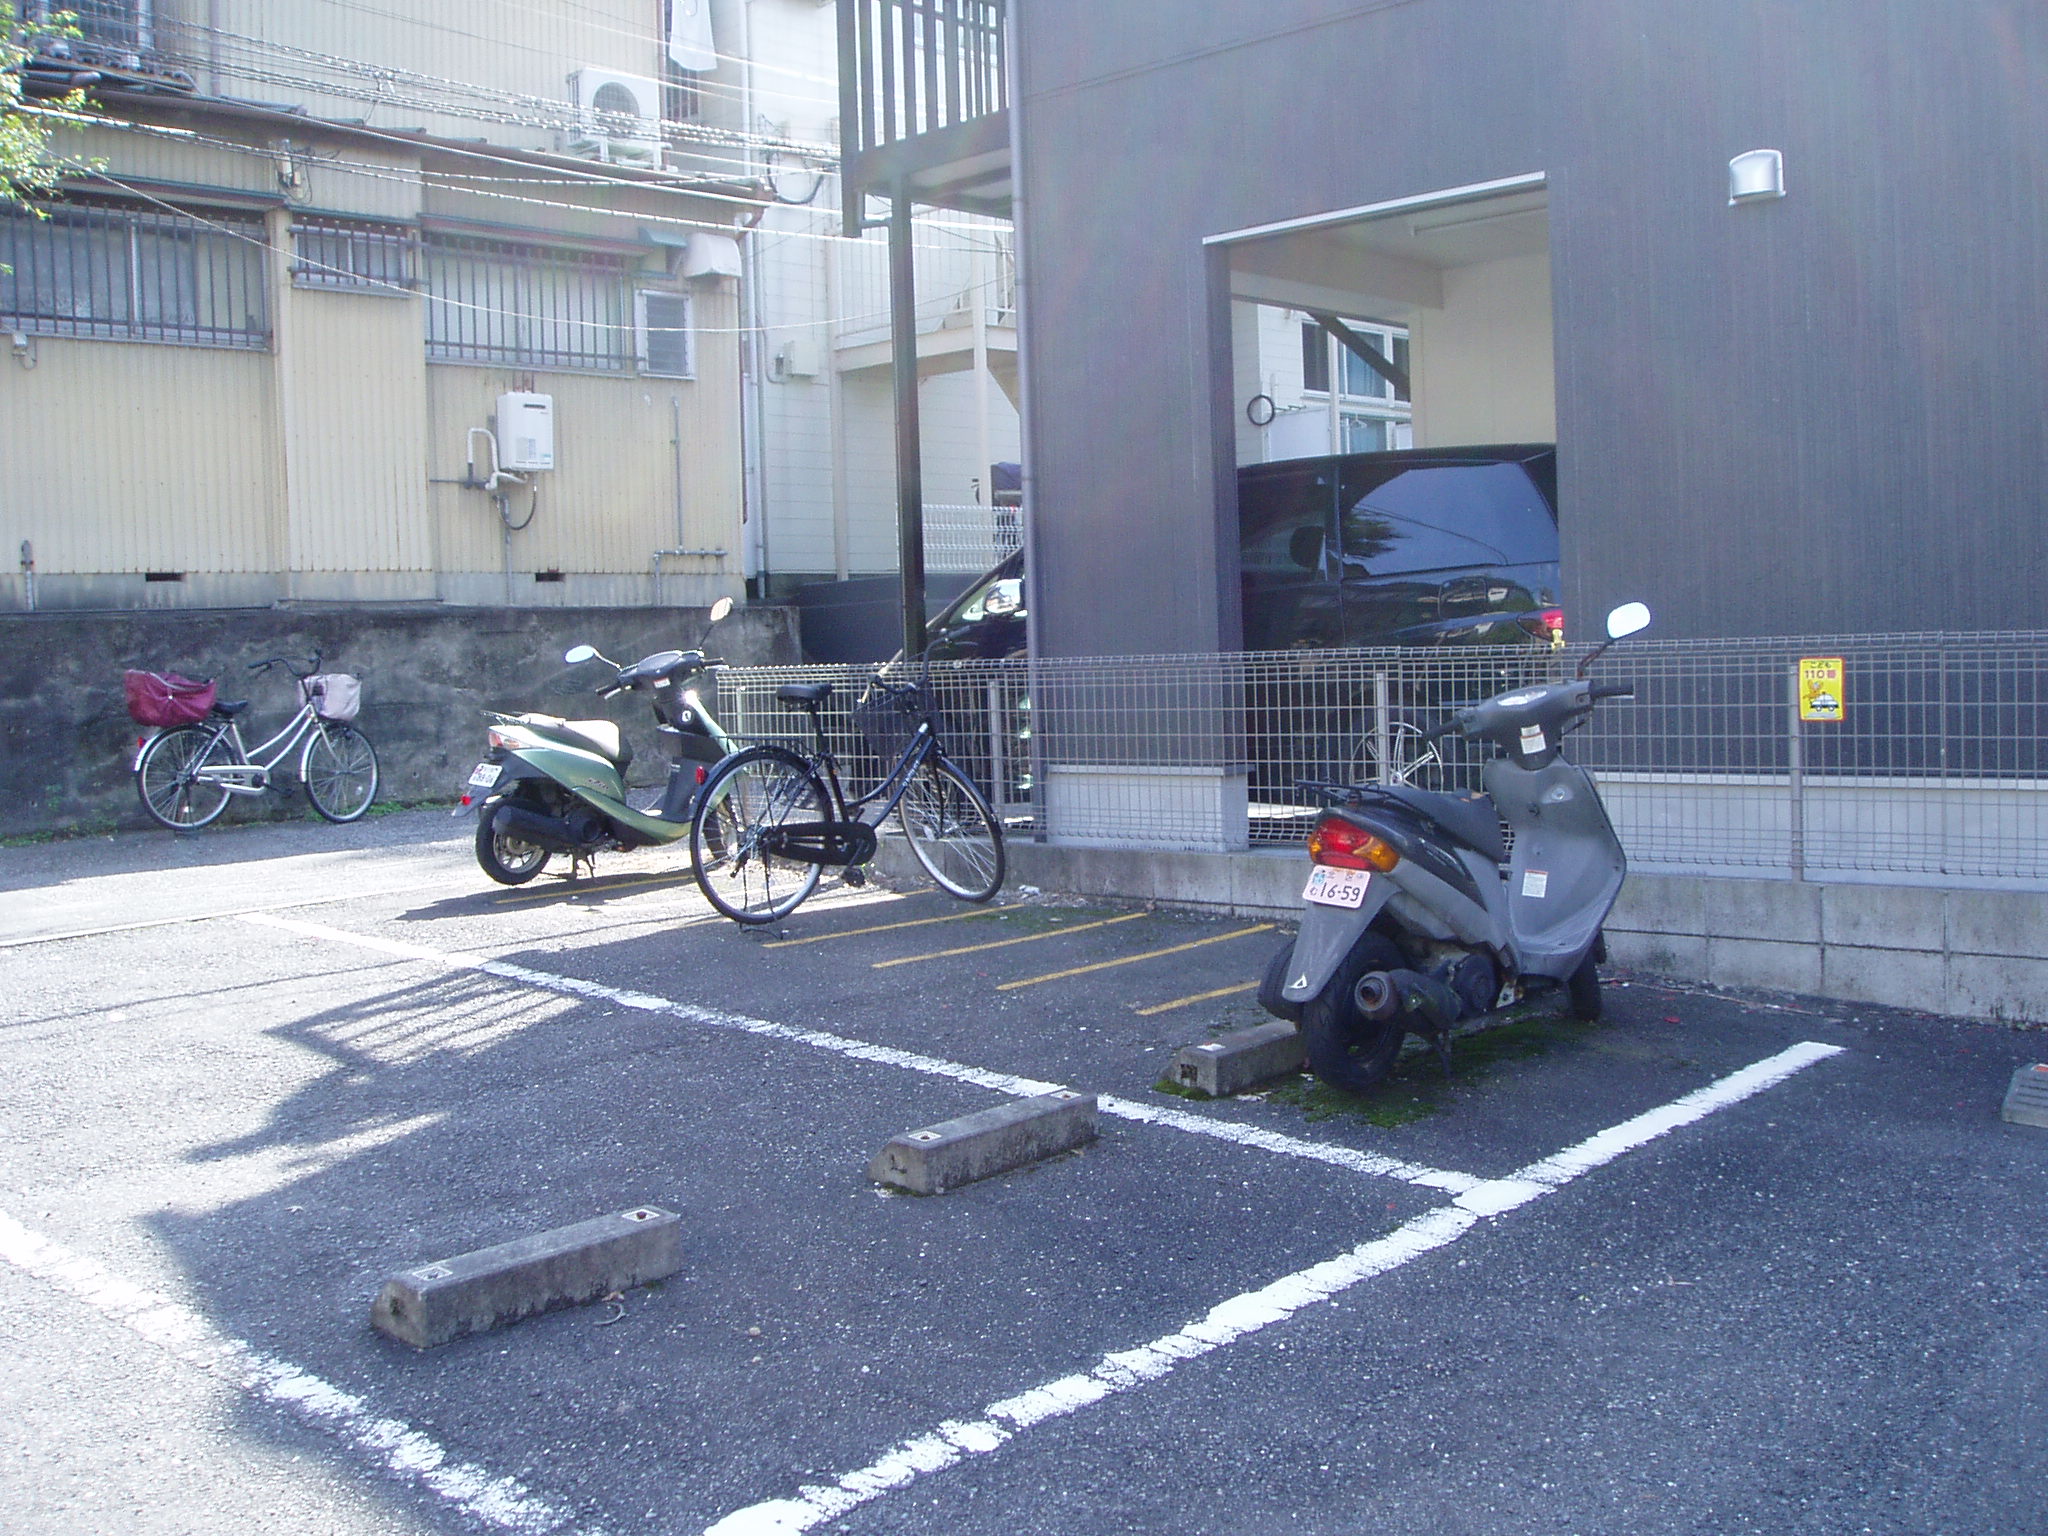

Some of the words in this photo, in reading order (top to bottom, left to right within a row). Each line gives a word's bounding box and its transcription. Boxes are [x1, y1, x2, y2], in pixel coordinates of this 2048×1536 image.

[1810, 661, 1832, 669] こども
[1320, 882, 1361, 902] 16-59
